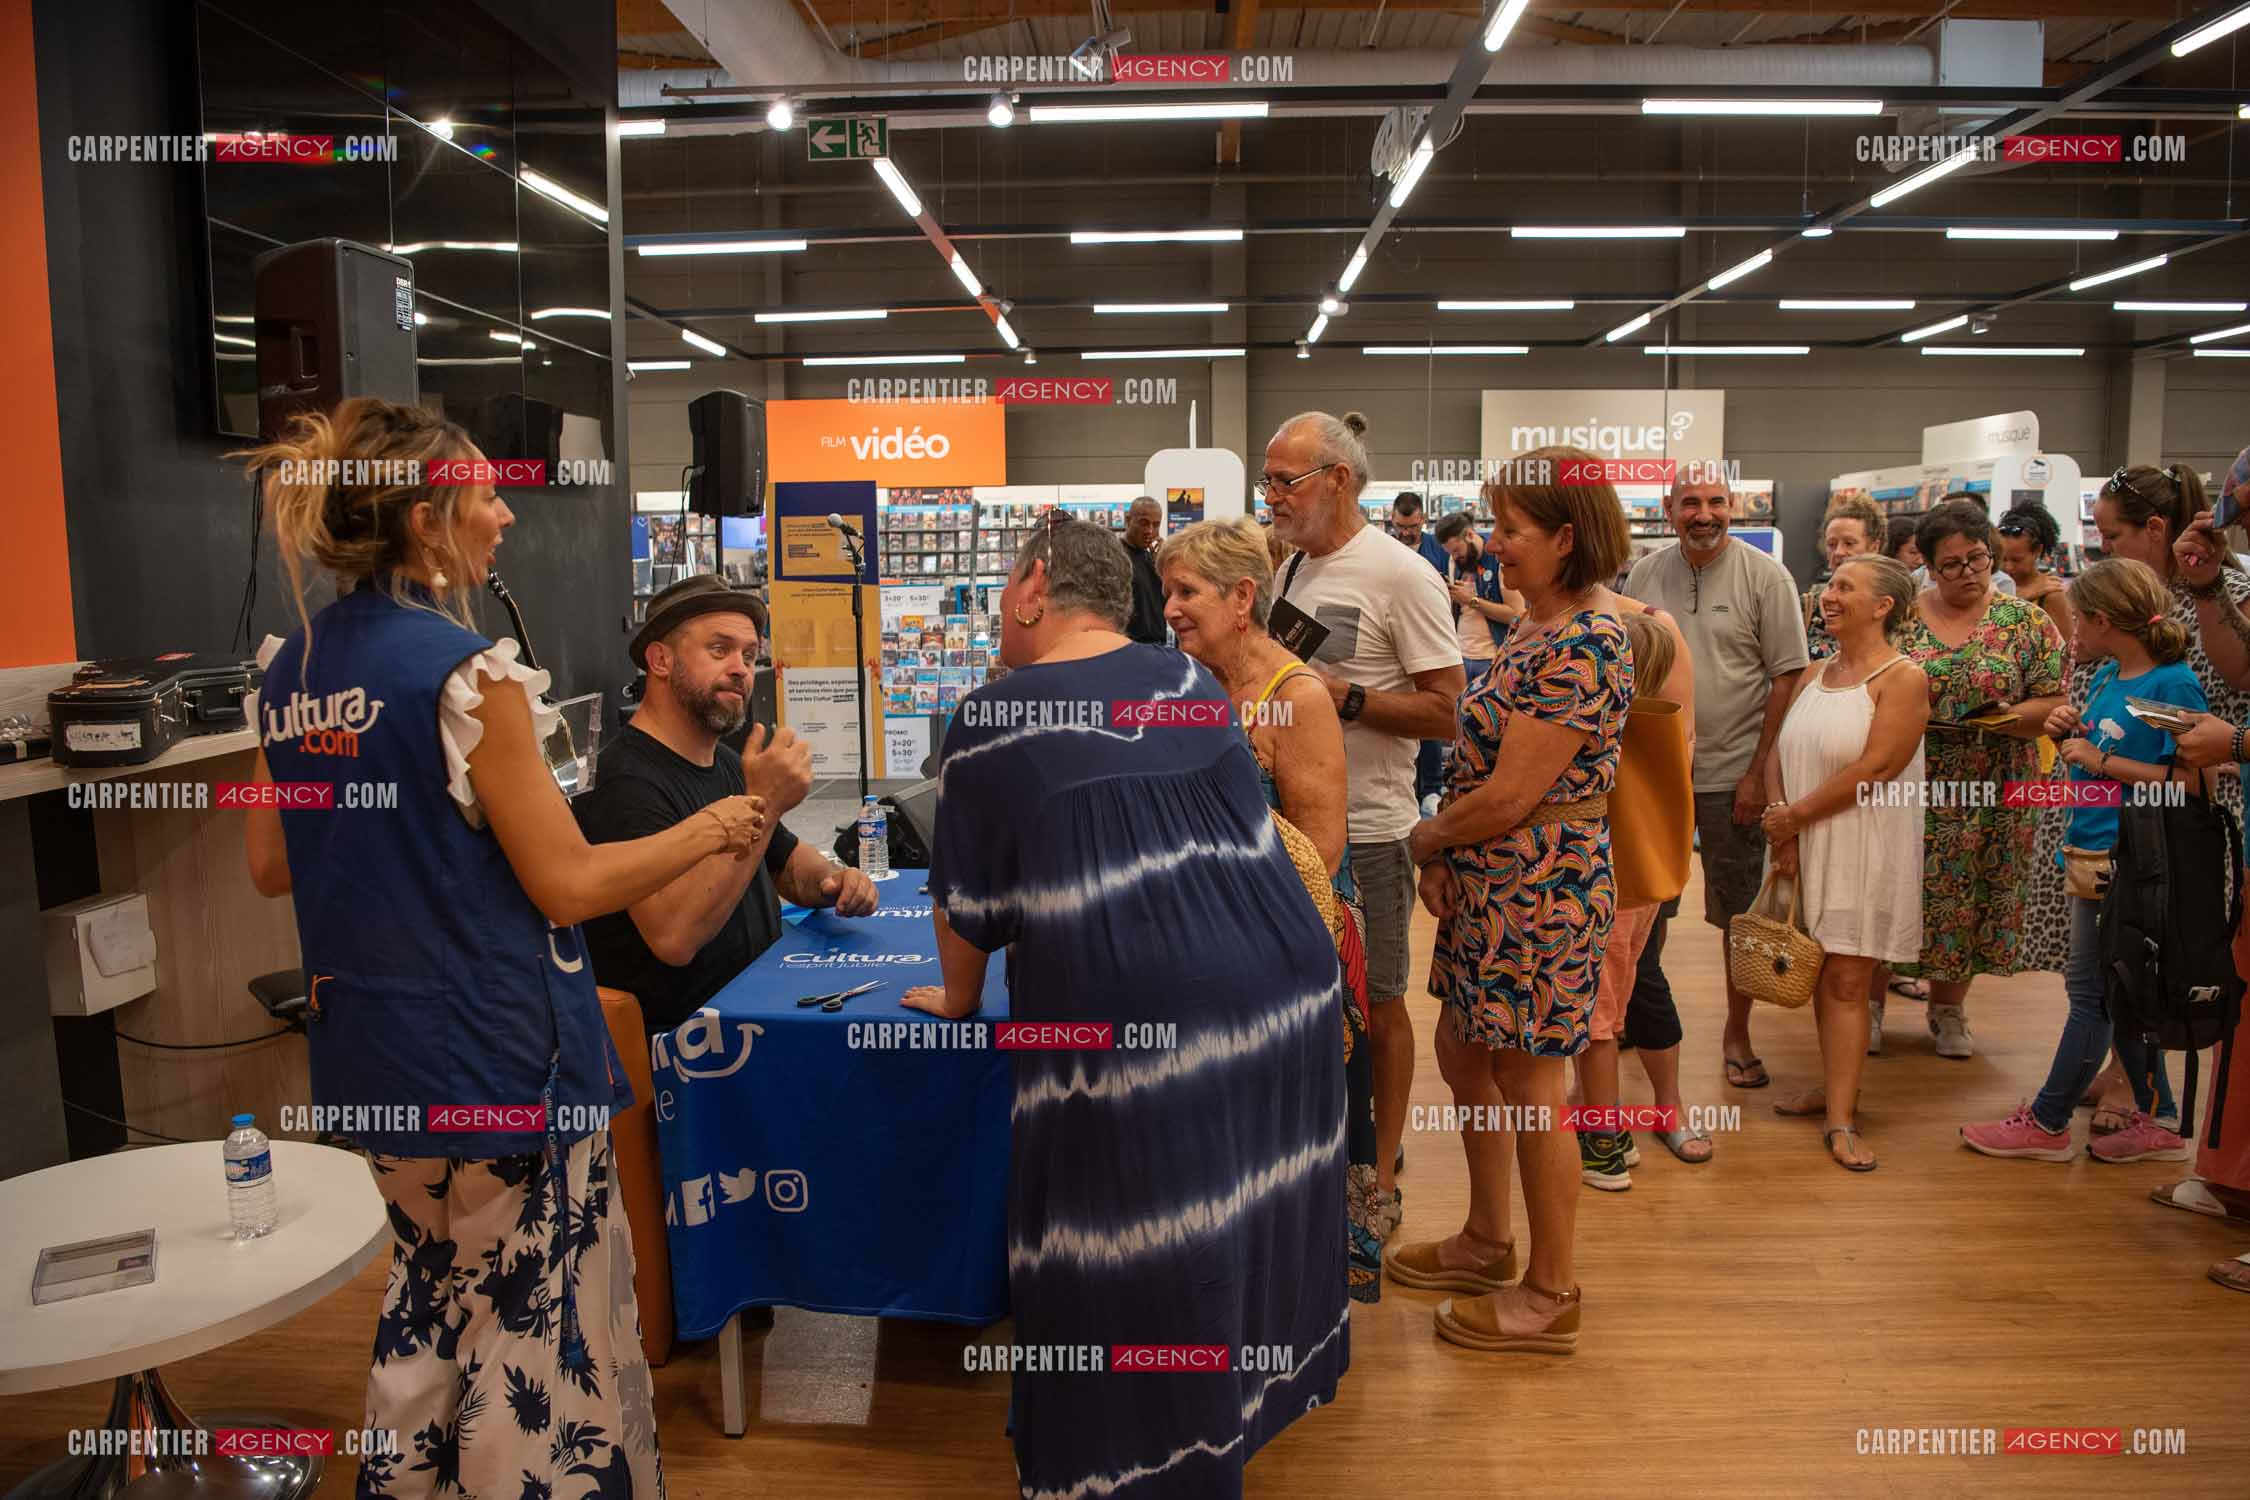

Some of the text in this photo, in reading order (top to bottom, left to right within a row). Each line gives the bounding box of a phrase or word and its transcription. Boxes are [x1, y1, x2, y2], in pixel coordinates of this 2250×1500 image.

[821, 424, 951, 461] FILM vidéo
[1511, 417, 1665, 460] musique
[298, 729, 361, 759] .com
[783, 948, 937, 965] Cultura
